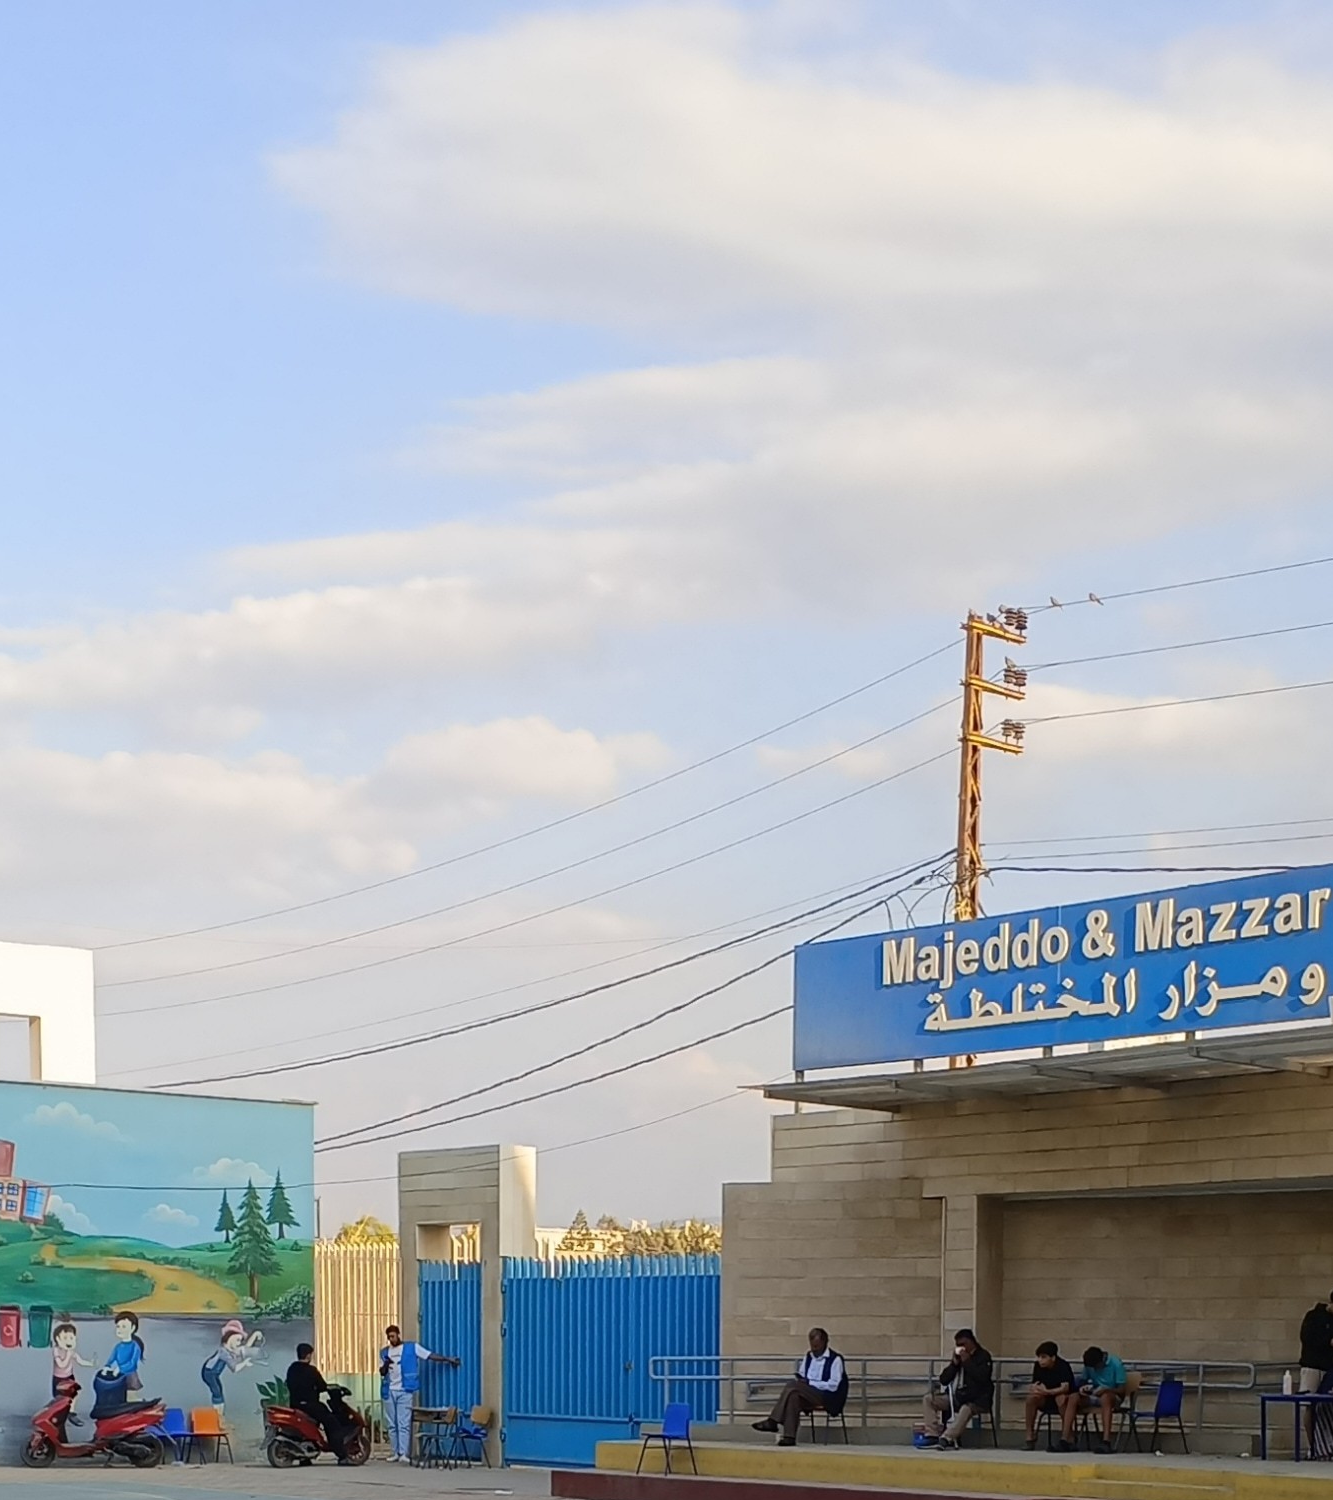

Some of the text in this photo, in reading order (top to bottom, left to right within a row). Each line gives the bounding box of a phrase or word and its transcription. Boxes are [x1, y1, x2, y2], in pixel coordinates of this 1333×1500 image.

[882, 918, 1069, 990] Majeddo
[1082, 909, 1116, 960] &
[1135, 887, 1331, 953] Mazzar
[923, 967, 1137, 1032] المختلطة
